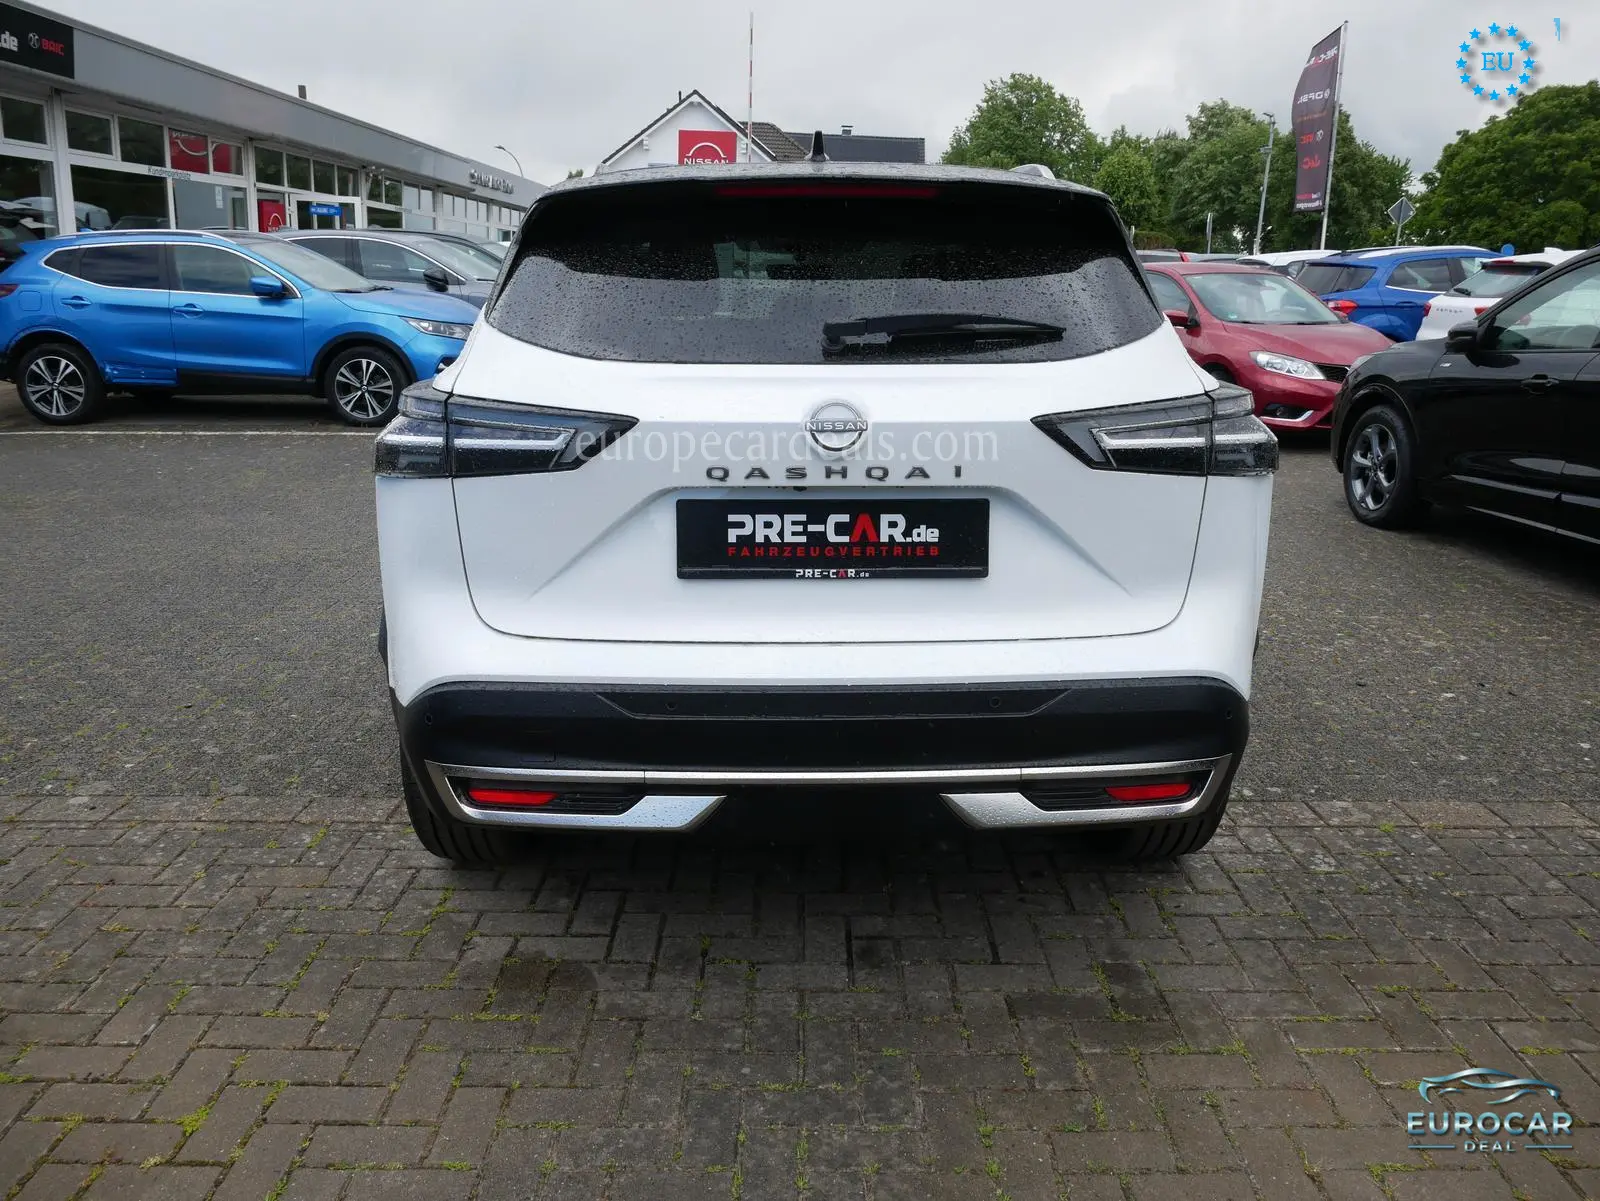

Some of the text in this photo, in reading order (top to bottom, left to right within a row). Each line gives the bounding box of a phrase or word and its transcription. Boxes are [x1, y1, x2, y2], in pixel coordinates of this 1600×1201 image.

[683, 157, 729, 165] NISSAN
[804, 420, 868, 432] NISSAN
[705, 465, 962, 482] QASHQAI
[727, 513, 940, 543] PRE-CAR.de
[727, 546, 940, 558] FAHRZEUGVERTRIEB
